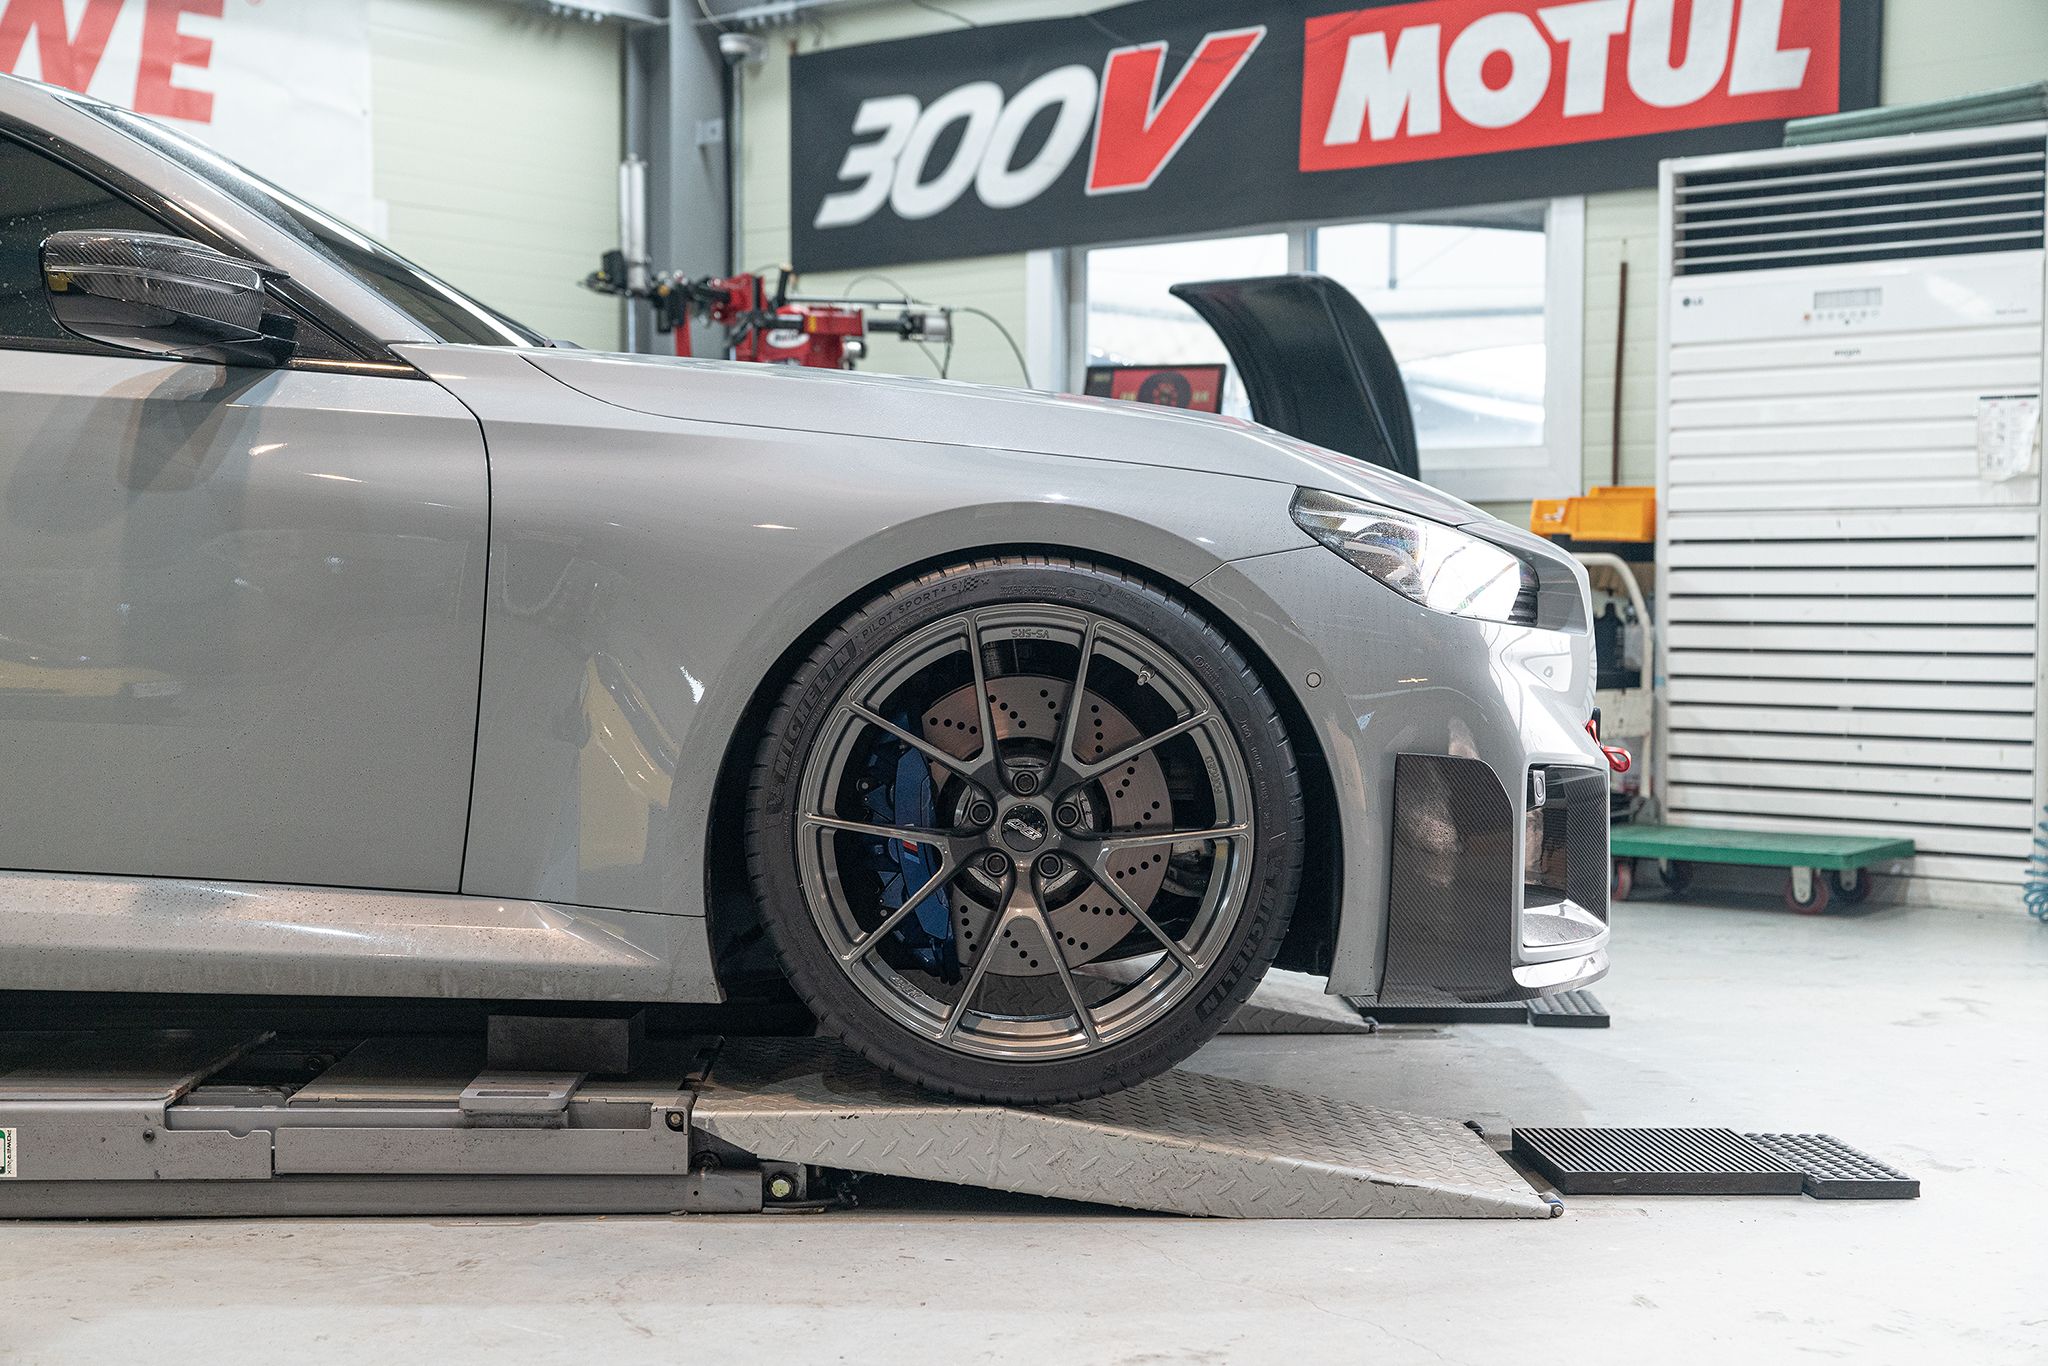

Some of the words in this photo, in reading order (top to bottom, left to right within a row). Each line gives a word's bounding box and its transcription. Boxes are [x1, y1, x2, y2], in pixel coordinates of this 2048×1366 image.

[813, 25, 1267, 229] 300V
[1323, 0, 1811, 147] MOTUL
[860, 611, 894, 639] PILOT
[772, 646, 850, 776] MICHELIN
[1197, 884, 1280, 1015] MICHELIN
